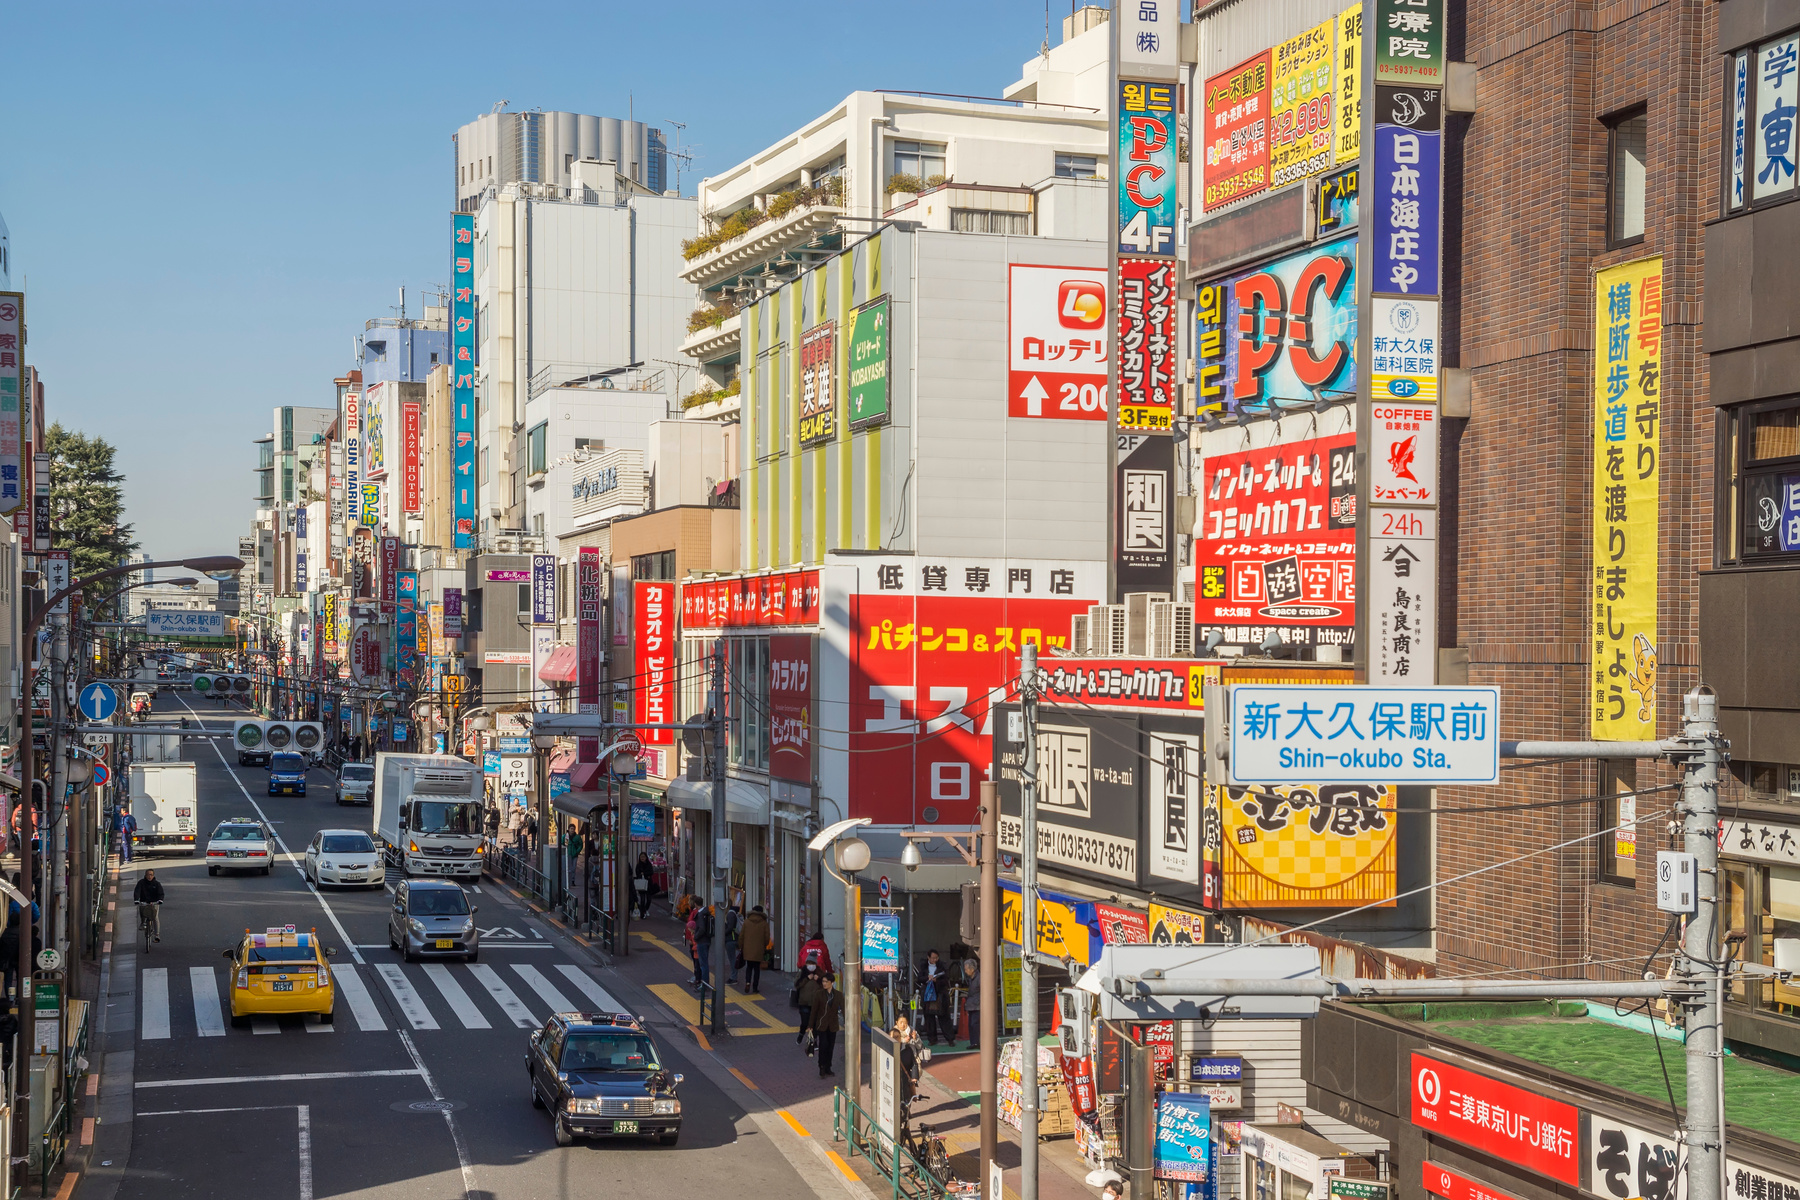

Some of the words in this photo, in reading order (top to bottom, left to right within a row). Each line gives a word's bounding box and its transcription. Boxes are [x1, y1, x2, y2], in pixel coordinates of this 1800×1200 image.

[1379, 63, 1438, 77] 03-5937-4092
[1122, 84, 1173, 112] 월드
[1207, 62, 1266, 113] イー不動産
[1422, 90, 1439, 102] 3F
[1389, 133, 1422, 294] 日本海庄や
[1120, 211, 1174, 253] 4F
[1123, 280, 1147, 404] コミックカフェ
[1148, 265, 1169, 403] インターネット&
[1234, 255, 1352, 401] PC
[856, 335, 881, 361] ビリヤード
[1373, 335, 1434, 355] 新大久保
[851, 360, 886, 388] KOBAYASHI
[1373, 355, 1434, 374] 歯科医院
[1636, 274, 1662, 481] 信号を守り
[456, 227, 473, 535] カラオケ&パーティー館
[803, 361, 831, 416] 英雄
[1395, 381, 1413, 394] 2F
[347, 394, 358, 432] HOTEL
[1373, 407, 1433, 421] COFFEE
[408, 414, 416, 458] PLAZA
[1118, 435, 1139, 448] 2F
[347, 438, 358, 466] SUN
[1, 464, 18, 500] 寝具
[408, 464, 416, 508] HOTEL
[1208, 454, 1323, 502] インターネット&
[1332, 459, 1356, 487] 24
[347, 470, 359, 521] MARINE
[1374, 485, 1431, 501] シュベール
[1604, 281, 1632, 721] 横断歩道を渡りましょう
[1126, 473, 1164, 549] 和民
[1207, 497, 1323, 540] コミックカフェ
[1381, 512, 1423, 536] 24h
[386, 551, 395, 575] Cafe
[1122, 554, 1168, 562] wa-ta-mi
[386, 583, 395, 600] Bar
[580, 565, 599, 621] 化粧品
[876, 563, 1075, 595] 低貸専門店
[1202, 576, 1225, 598] 3F
[150, 613, 221, 626] 新大久保駅前
[646, 586, 663, 651] カラオケ
[1269, 607, 1297, 618] space
[1299, 607, 1331, 617] create
[160, 624, 197, 633] Shin-okubo
[771, 658, 809, 692] カラオケ
[771, 714, 809, 749] ビッグエコー
[1243, 701, 1487, 742] 新大久保駅前
[1279, 746, 1403, 769] Shin-okubo
[1412, 747, 1452, 769] Sta.
[501, 779, 533, 788] ルノアール
[1093, 766, 1134, 786] wa-ta-mi
[1165, 745, 1188, 852] 和民
[1740, 822, 1797, 857] あなた
[1205, 872, 1219, 899] B1
[1192, 1064, 1241, 1076] 日本海庄や
[1159, 1101, 1200, 1123] 分煙で
[1209, 1095, 1236, 1104] ベール
[618, 1124, 638, 1133] 37-52
[1158, 1114, 1208, 1140] 思いやりの
[1421, 1107, 1437, 1122] MUFG
[1449, 1089, 1573, 1159] 三菱東京UFJ銀行
